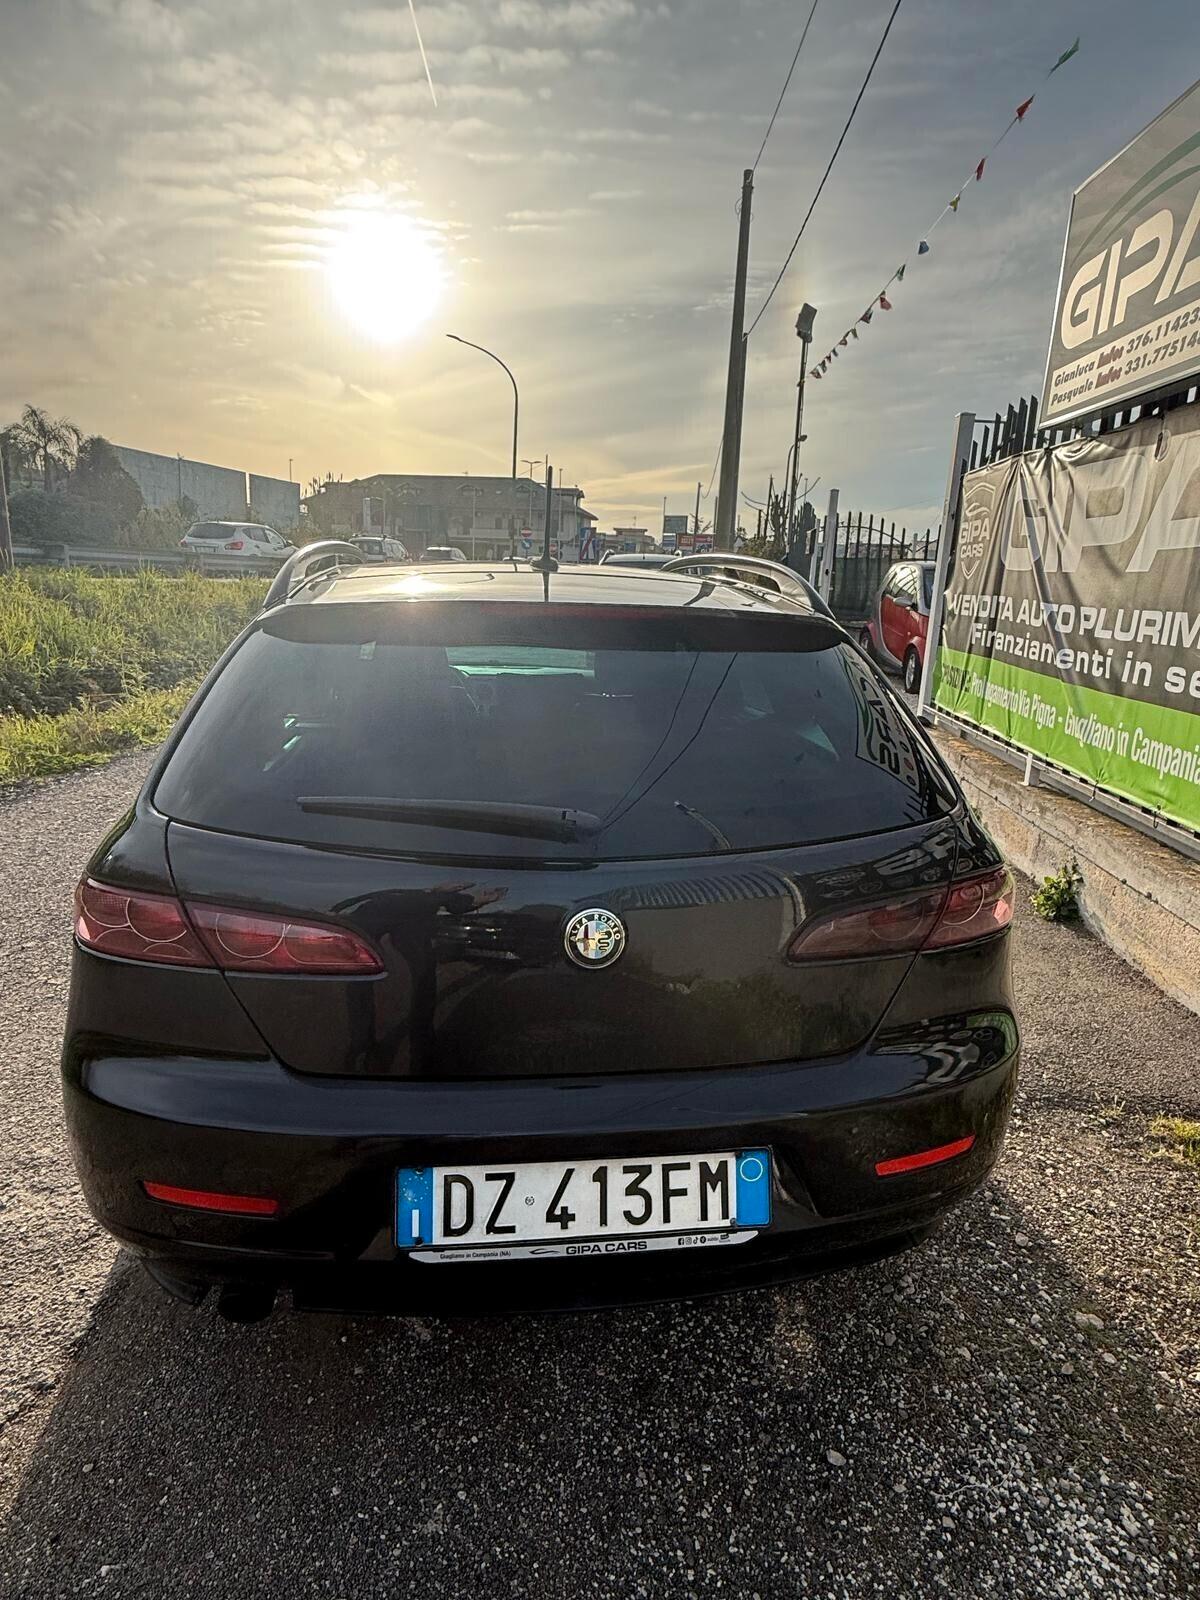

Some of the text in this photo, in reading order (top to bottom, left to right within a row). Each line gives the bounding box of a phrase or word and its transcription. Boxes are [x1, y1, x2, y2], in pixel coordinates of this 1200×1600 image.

[1054, 361, 1095, 387] Gianluca
[1126, 307, 1200, 354] 376.11423
[1051, 381, 1094, 406] Pasquale
[960, 518, 989, 541] GIPA
[960, 543, 983, 558] CARS
[953, 594, 1013, 622] VENDITA
[1016, 599, 1075, 634] AUTO
[1121, 651, 1152, 687] in
[1030, 693, 1057, 730] Pigna
[1116, 722, 1130, 757] in
[593, 913, 621, 940] ROMEO
[442, 1159, 731, 1237] DZ 413FM
[565, 1240, 648, 1255] GIPA CARS
